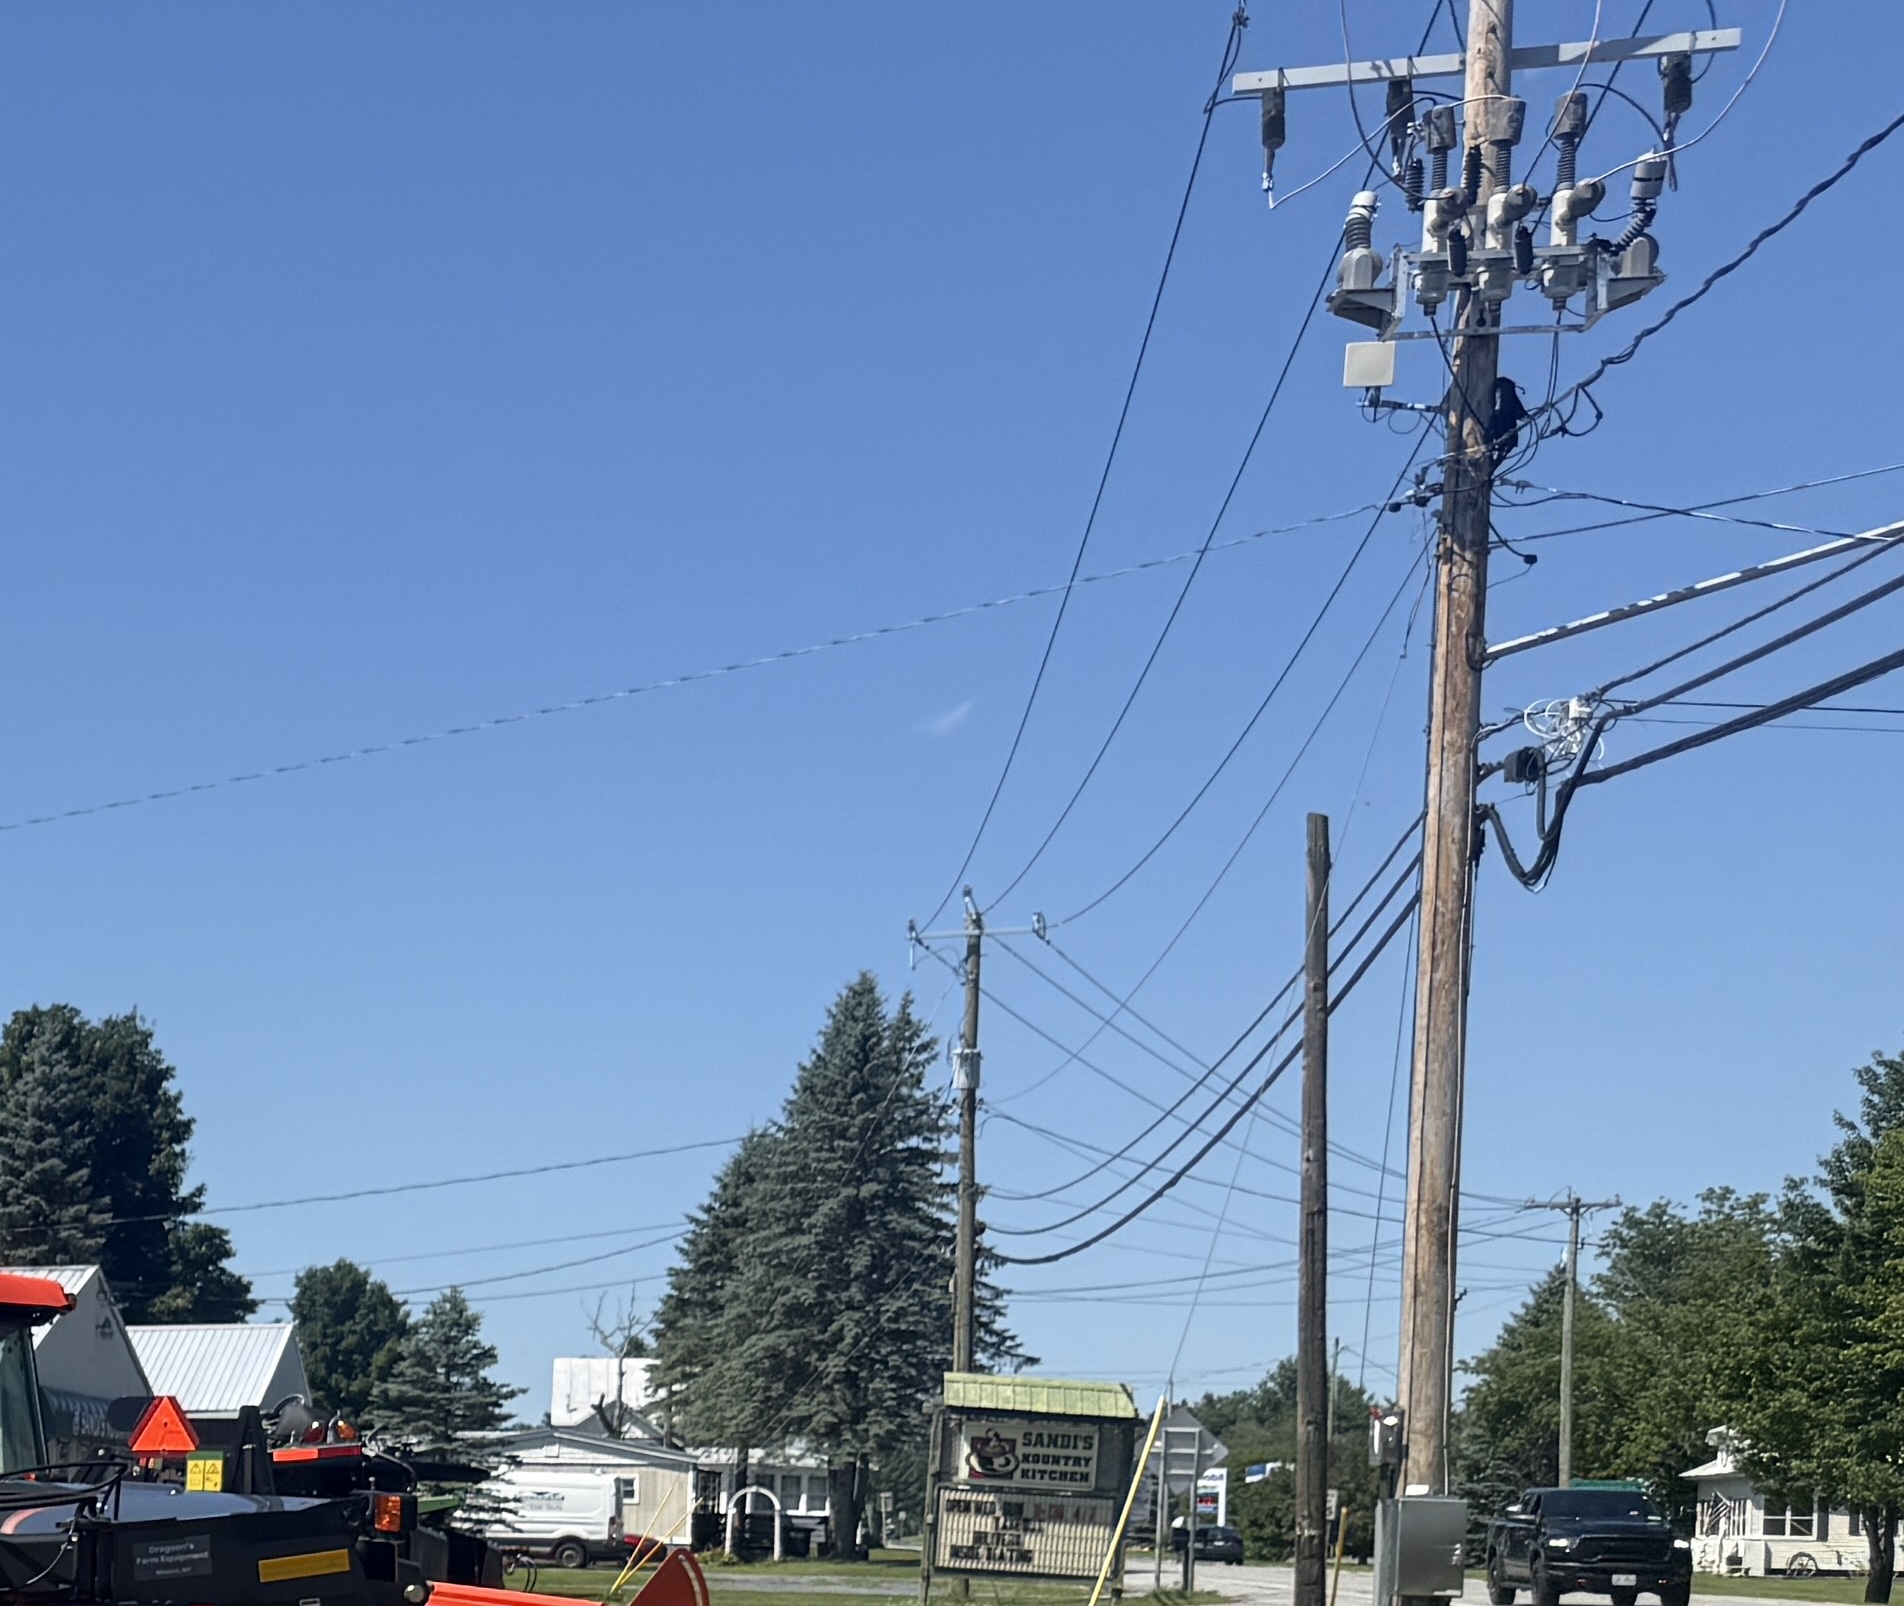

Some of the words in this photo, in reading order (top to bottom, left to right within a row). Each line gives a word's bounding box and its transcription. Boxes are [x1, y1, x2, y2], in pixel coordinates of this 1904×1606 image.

[1021, 1431, 1094, 1451] SANDI'S
[1021, 1452, 1092, 1468] KOUNTRY
[1020, 1468, 1090, 1483] KITCHEN
[135, 1557, 160, 1565] Farm
[160, 1551, 209, 1564] Equipment
